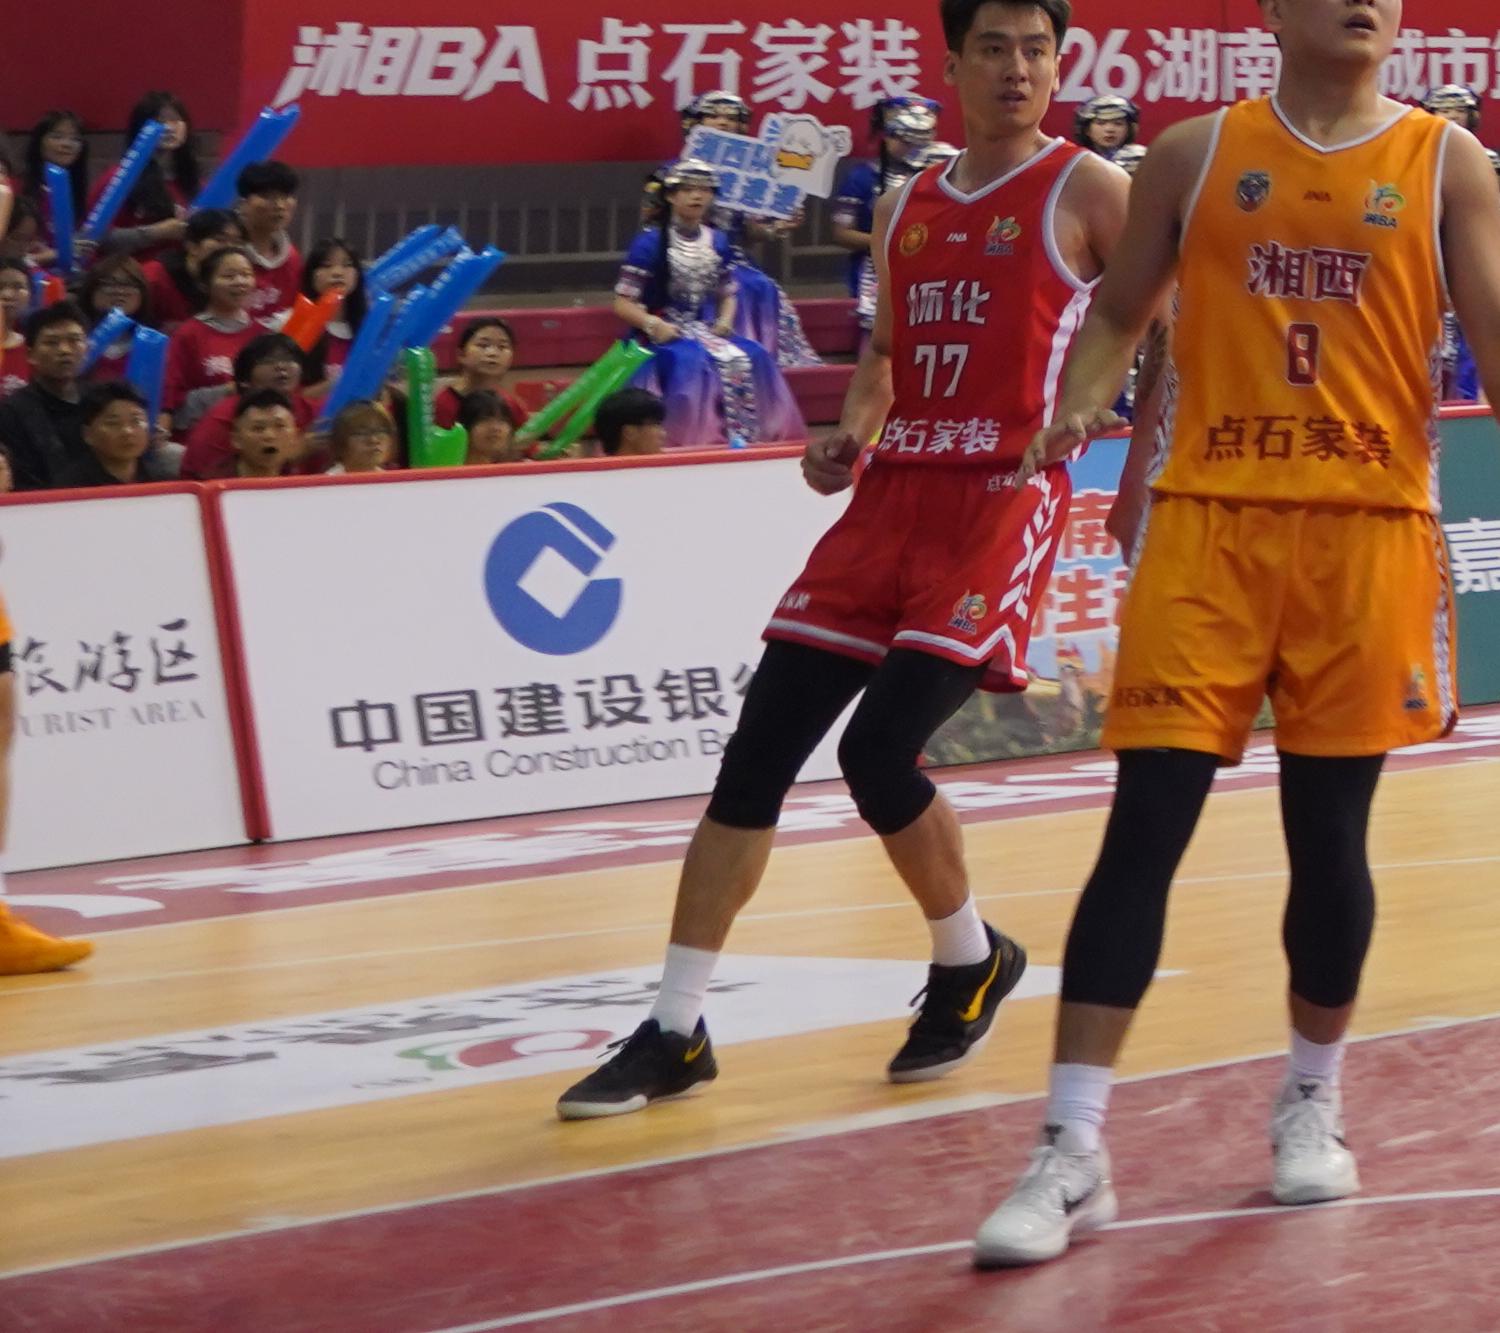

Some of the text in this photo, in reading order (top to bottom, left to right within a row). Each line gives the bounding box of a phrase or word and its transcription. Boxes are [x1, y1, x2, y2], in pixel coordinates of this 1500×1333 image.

[569, 17, 922, 110] 点石家装
[1247, 241, 1372, 307] 湘西
[914, 344, 969, 399] 77
[1286, 322, 1321, 387] 8
[1202, 415, 1394, 470] 点石家装
[373, 756, 476, 794] China
[486, 729, 693, 782] Construction
